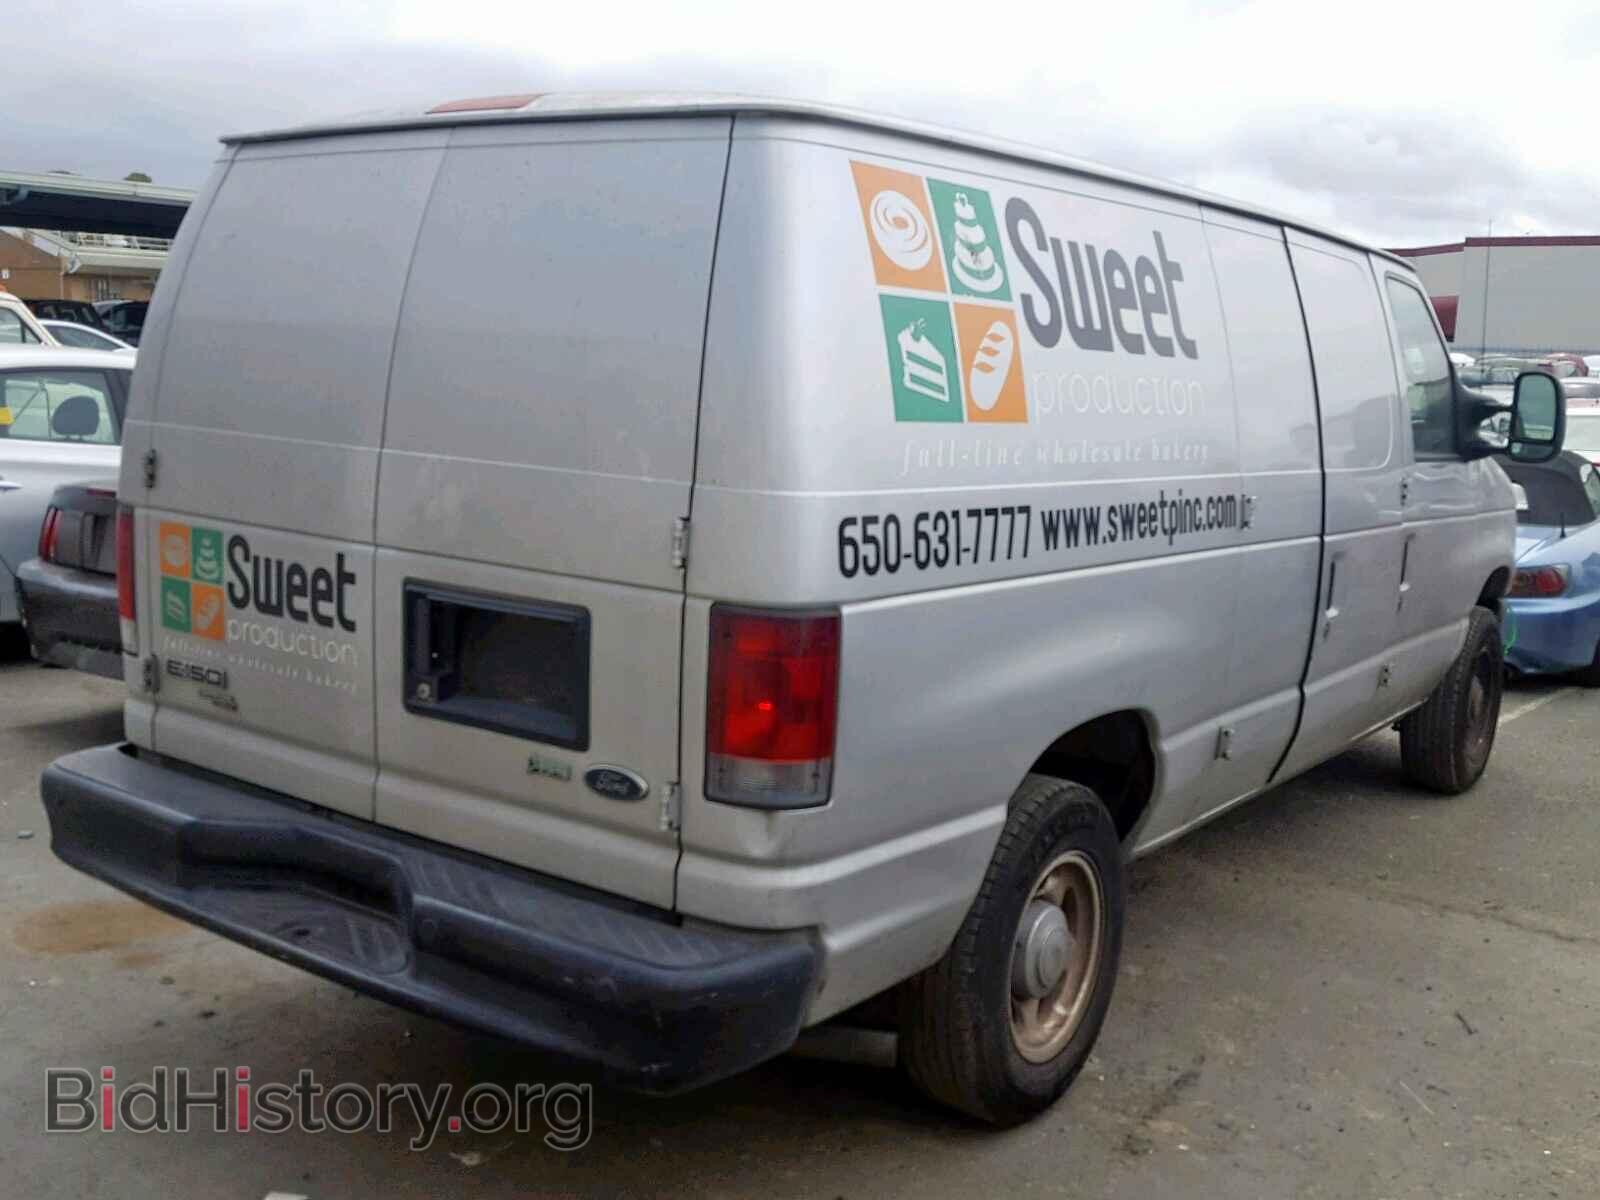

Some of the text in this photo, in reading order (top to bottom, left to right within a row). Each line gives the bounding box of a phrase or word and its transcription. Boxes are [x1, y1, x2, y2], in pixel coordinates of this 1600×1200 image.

[1005, 197, 1199, 360] Sweet
[1031, 369, 1204, 422] production
[838, 505, 1032, 578] 650-631-7777
[1041, 490, 1236, 551] www.sweetpinc.com
[227, 534, 356, 632] Sweet
[227, 619, 358, 667] production
